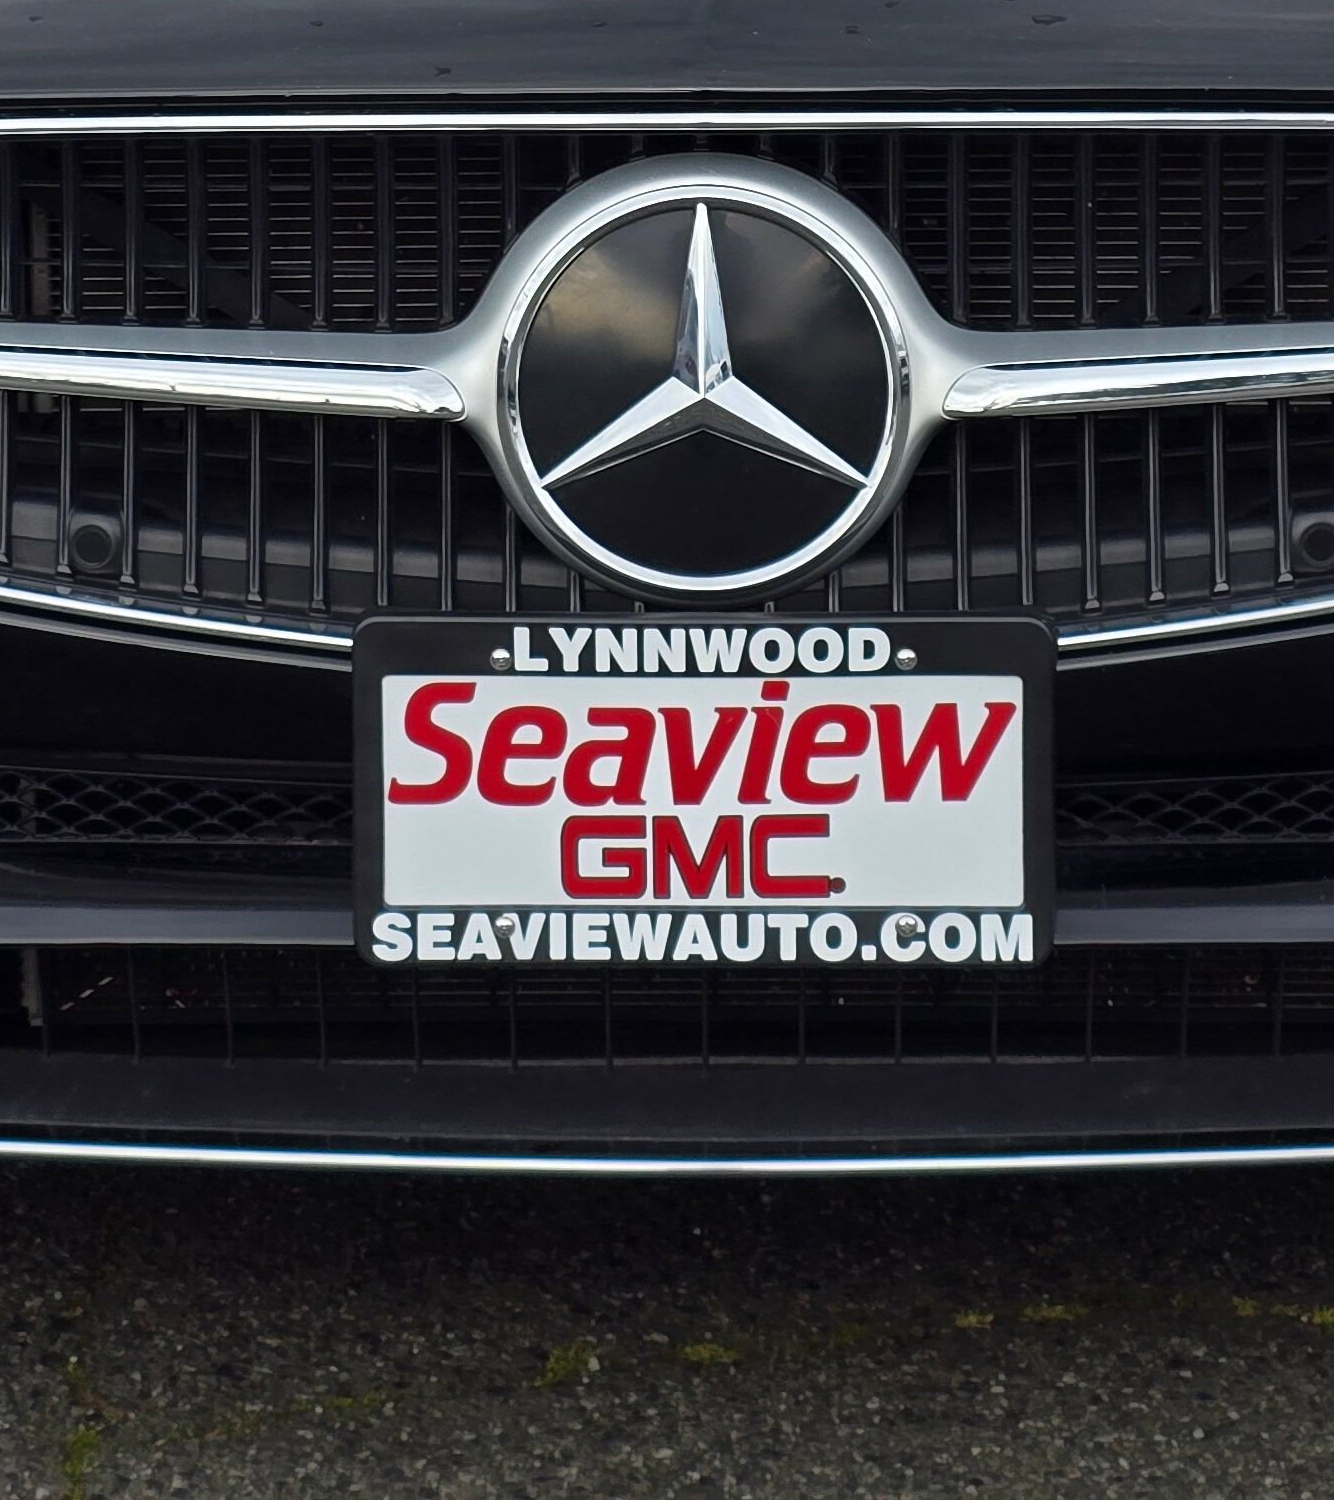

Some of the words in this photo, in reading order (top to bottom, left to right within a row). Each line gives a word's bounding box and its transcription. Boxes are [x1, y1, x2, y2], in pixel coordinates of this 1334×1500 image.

[513, 626, 891, 673] LYNNWOOD
[387, 680, 1017, 806] Seaview
[560, 814, 831, 899] GMC
[371, 912, 1035, 963] SEAVIEWAUTO.COM
